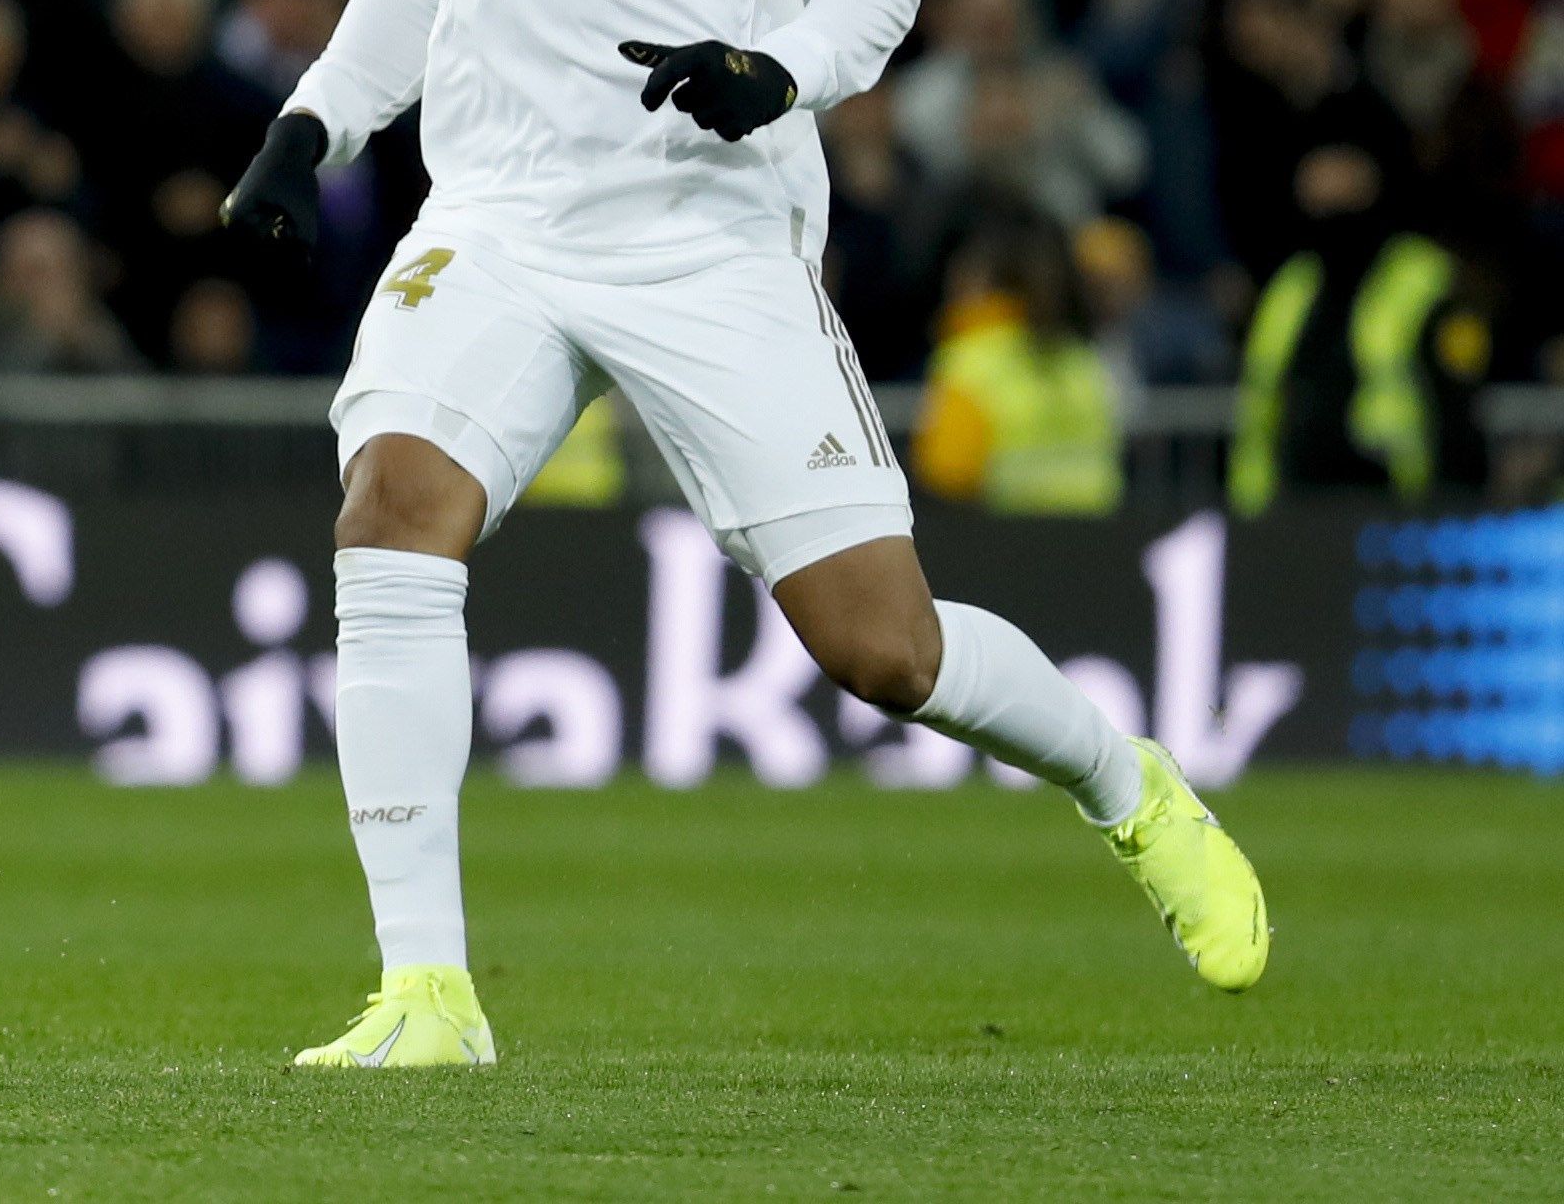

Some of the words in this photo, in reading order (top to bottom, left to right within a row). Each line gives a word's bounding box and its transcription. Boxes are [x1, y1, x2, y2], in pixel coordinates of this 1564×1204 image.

[378, 247, 456, 312] 4
[807, 453, 857, 470] adidas
[349, 804, 427, 825] RMCF
